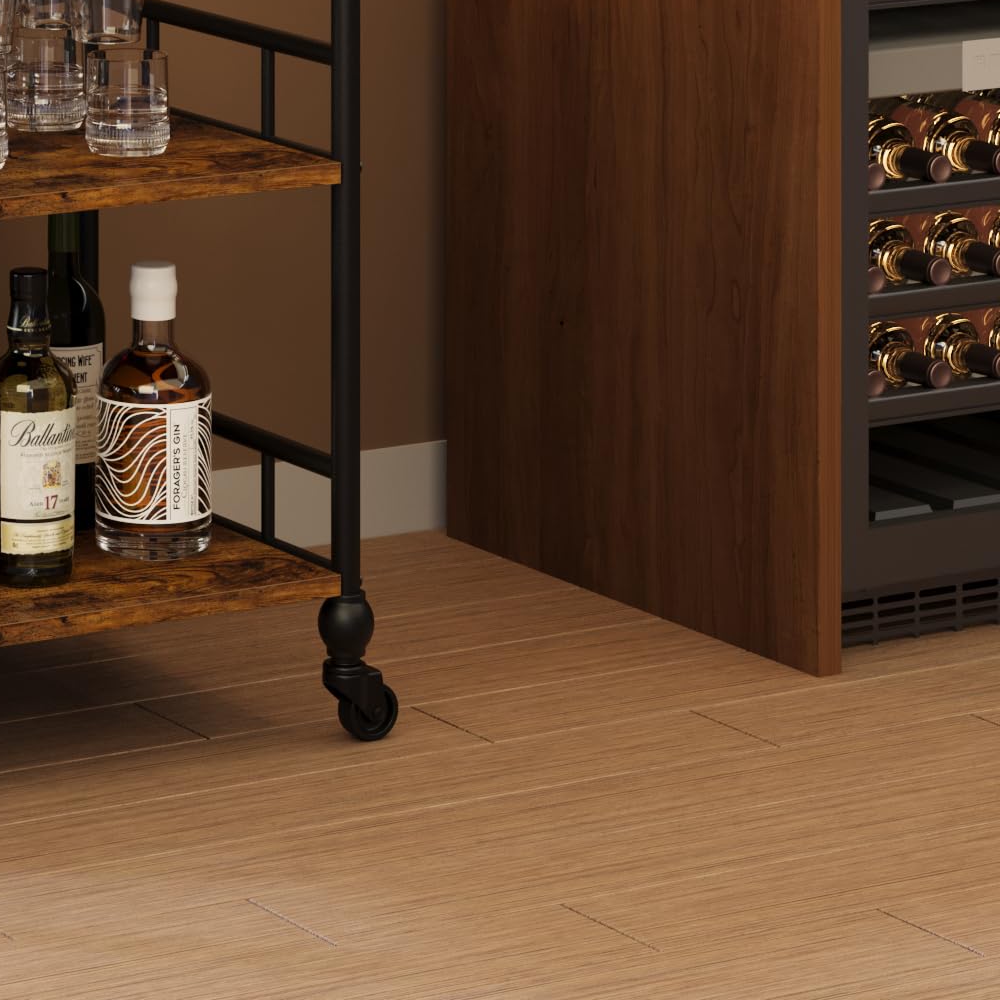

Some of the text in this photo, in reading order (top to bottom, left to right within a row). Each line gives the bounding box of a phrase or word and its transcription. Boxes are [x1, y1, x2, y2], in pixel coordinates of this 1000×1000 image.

[173, 424, 181, 510] FORAGER'S GIN
[44, 494, 58, 510] 17
